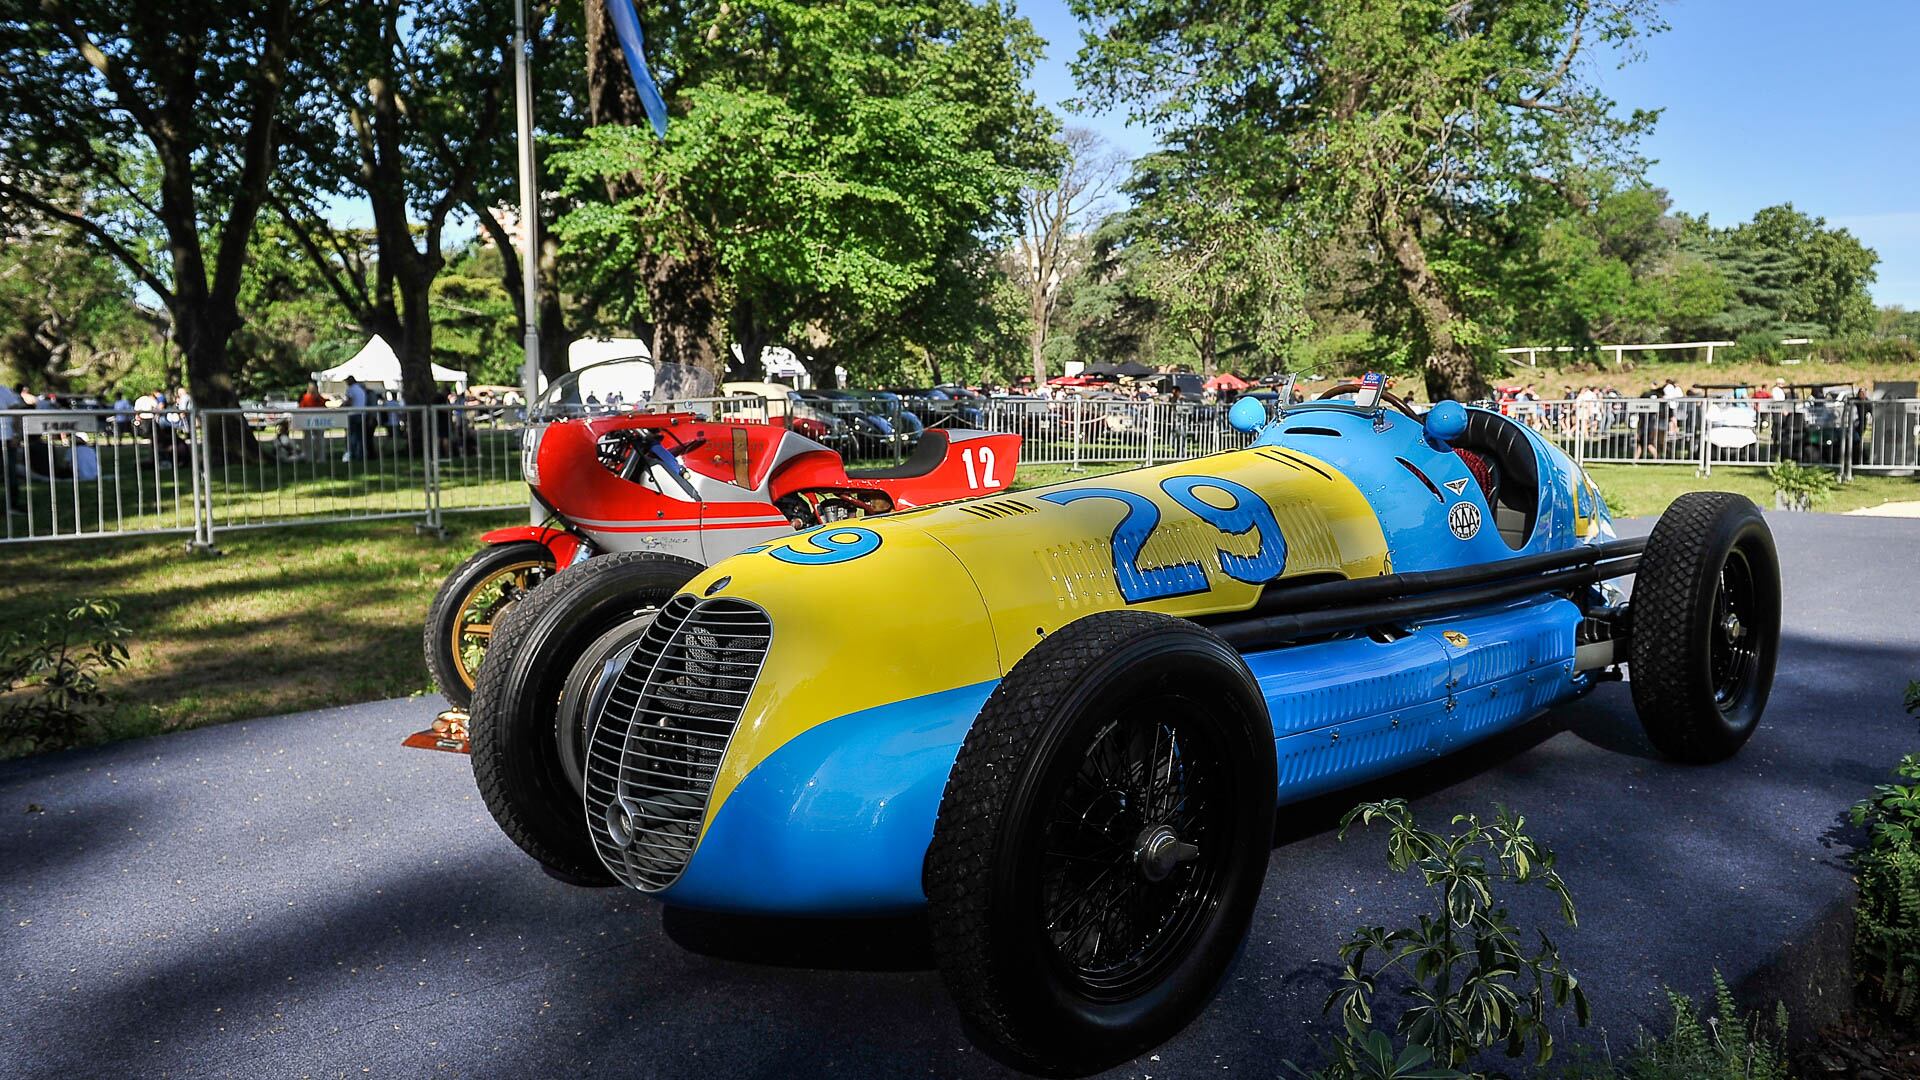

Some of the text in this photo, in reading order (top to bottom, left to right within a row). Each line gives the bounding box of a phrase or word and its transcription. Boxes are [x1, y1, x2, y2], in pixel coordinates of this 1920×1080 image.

[962, 446, 1000, 489] 12
[1037, 475, 1287, 605] 29
[1455, 506, 1477, 537] AAA
[738, 524, 884, 565] 9
